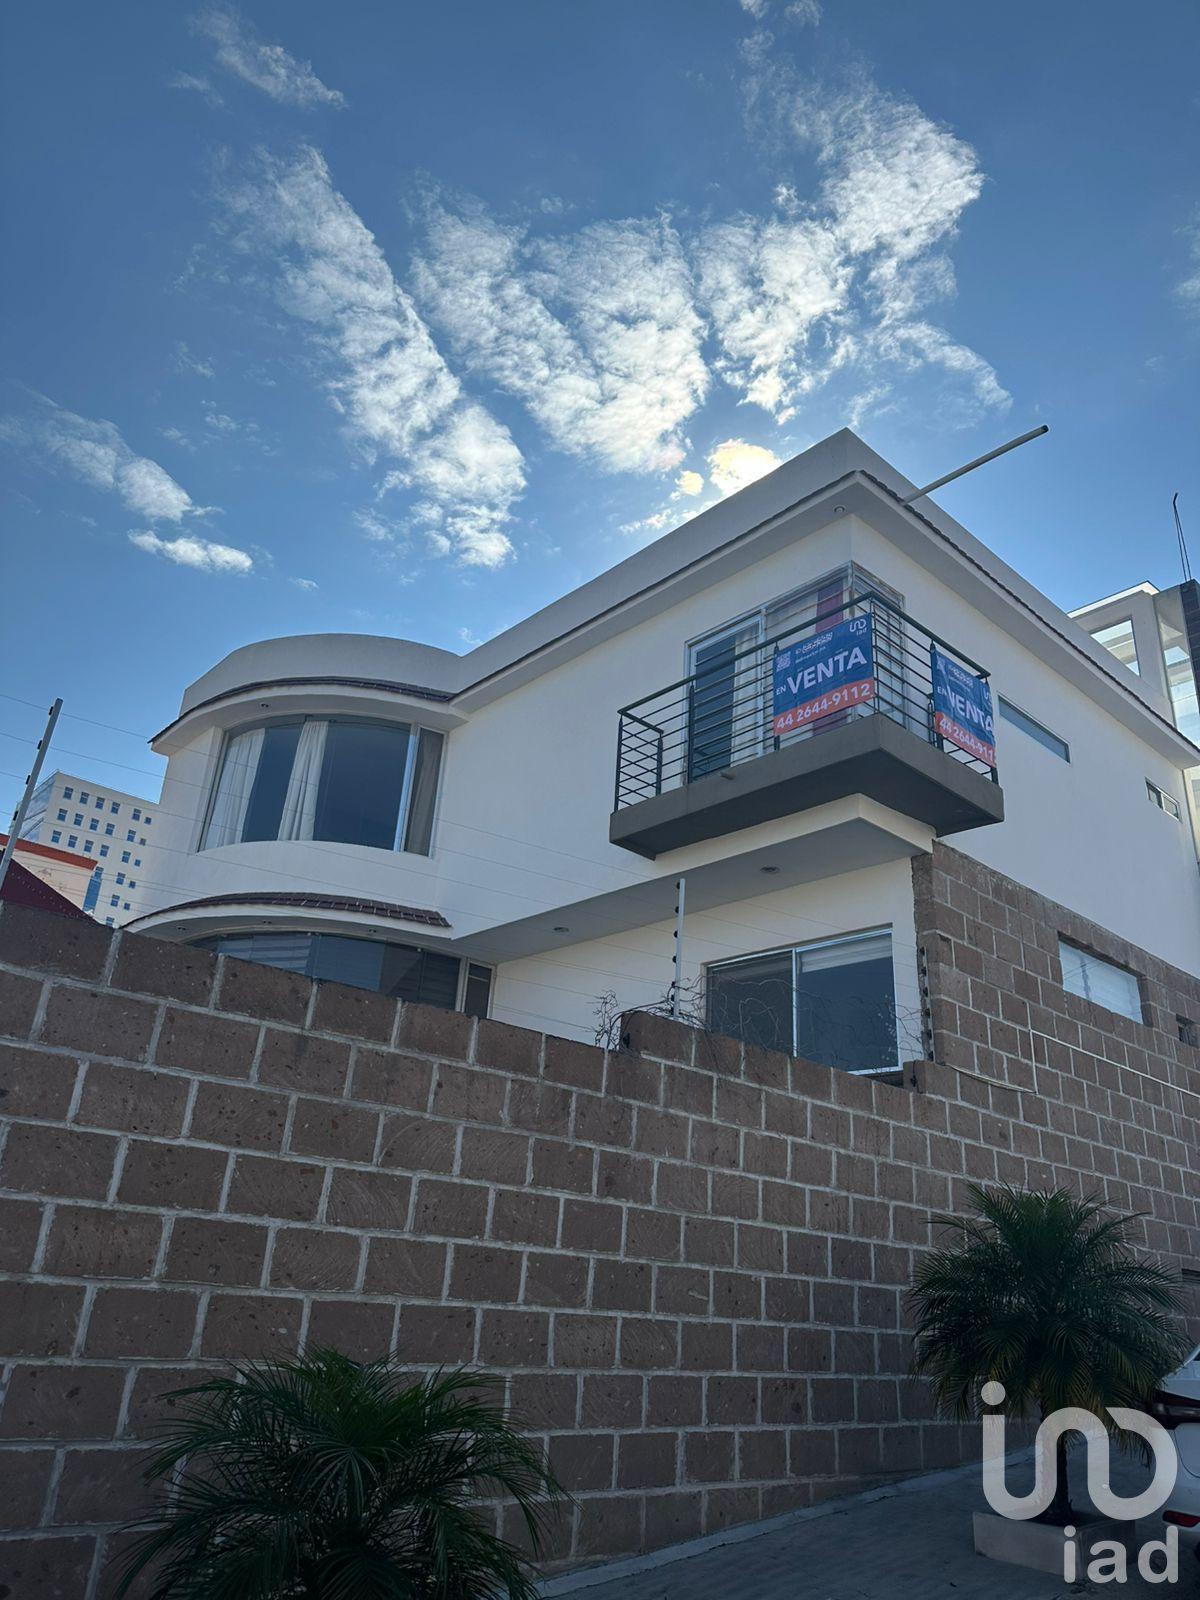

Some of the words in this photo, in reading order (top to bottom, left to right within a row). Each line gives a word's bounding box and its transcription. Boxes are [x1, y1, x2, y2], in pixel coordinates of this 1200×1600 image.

[776, 685, 786, 695] EN
[787, 646, 867, 695] VENTA
[937, 685, 947, 697] EN
[777, 716, 794, 729] 44
[796, 683, 870, 722] 2644-9112
[939, 718, 952, 733] 44
[953, 726, 994, 762] 2644-911
